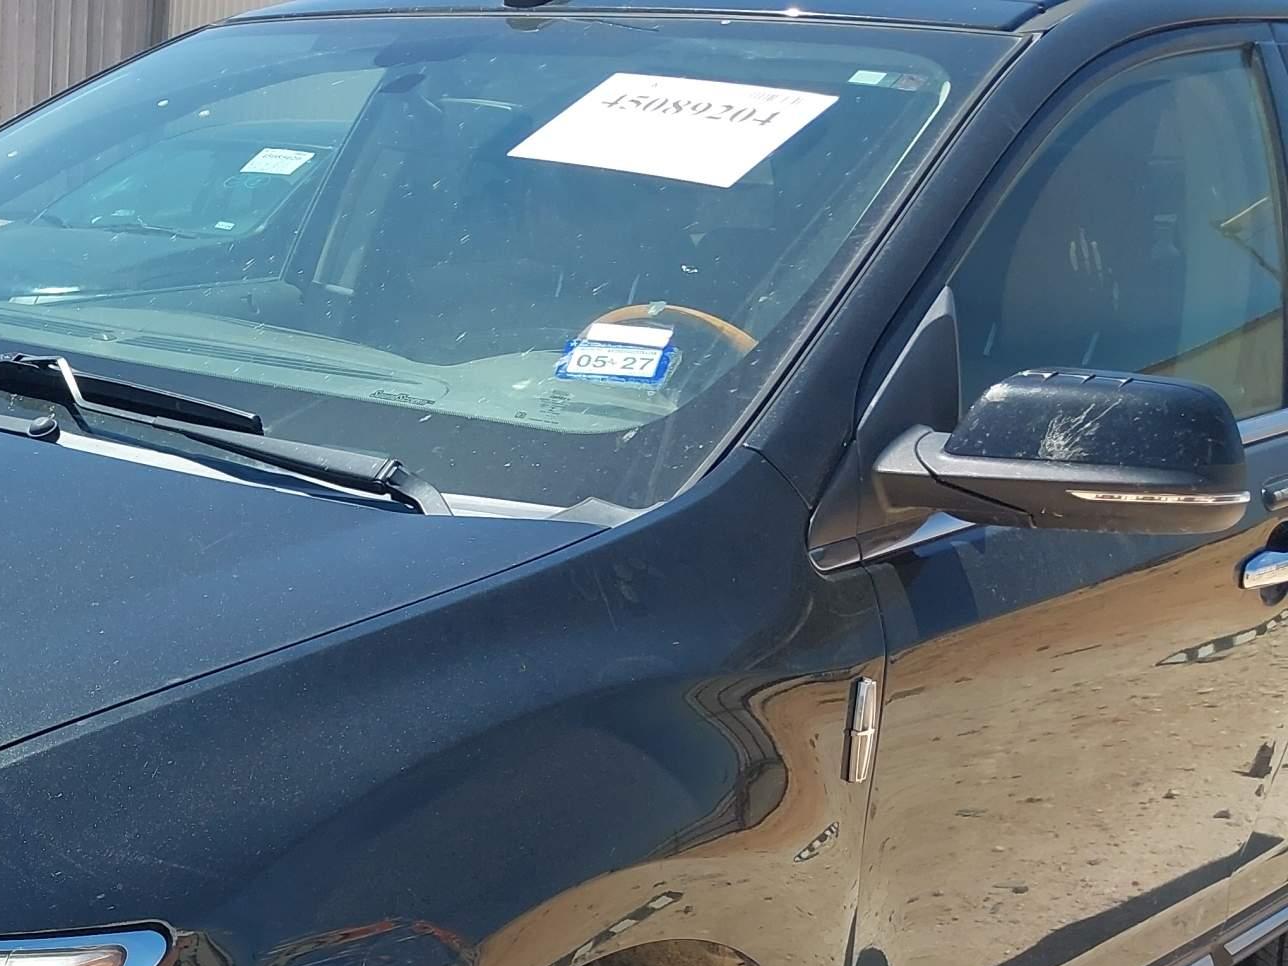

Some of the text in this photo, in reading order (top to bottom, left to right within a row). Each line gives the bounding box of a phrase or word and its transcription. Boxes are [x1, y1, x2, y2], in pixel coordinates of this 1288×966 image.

[601, 93, 781, 127] 45089204
[575, 354, 655, 371] 05 27
